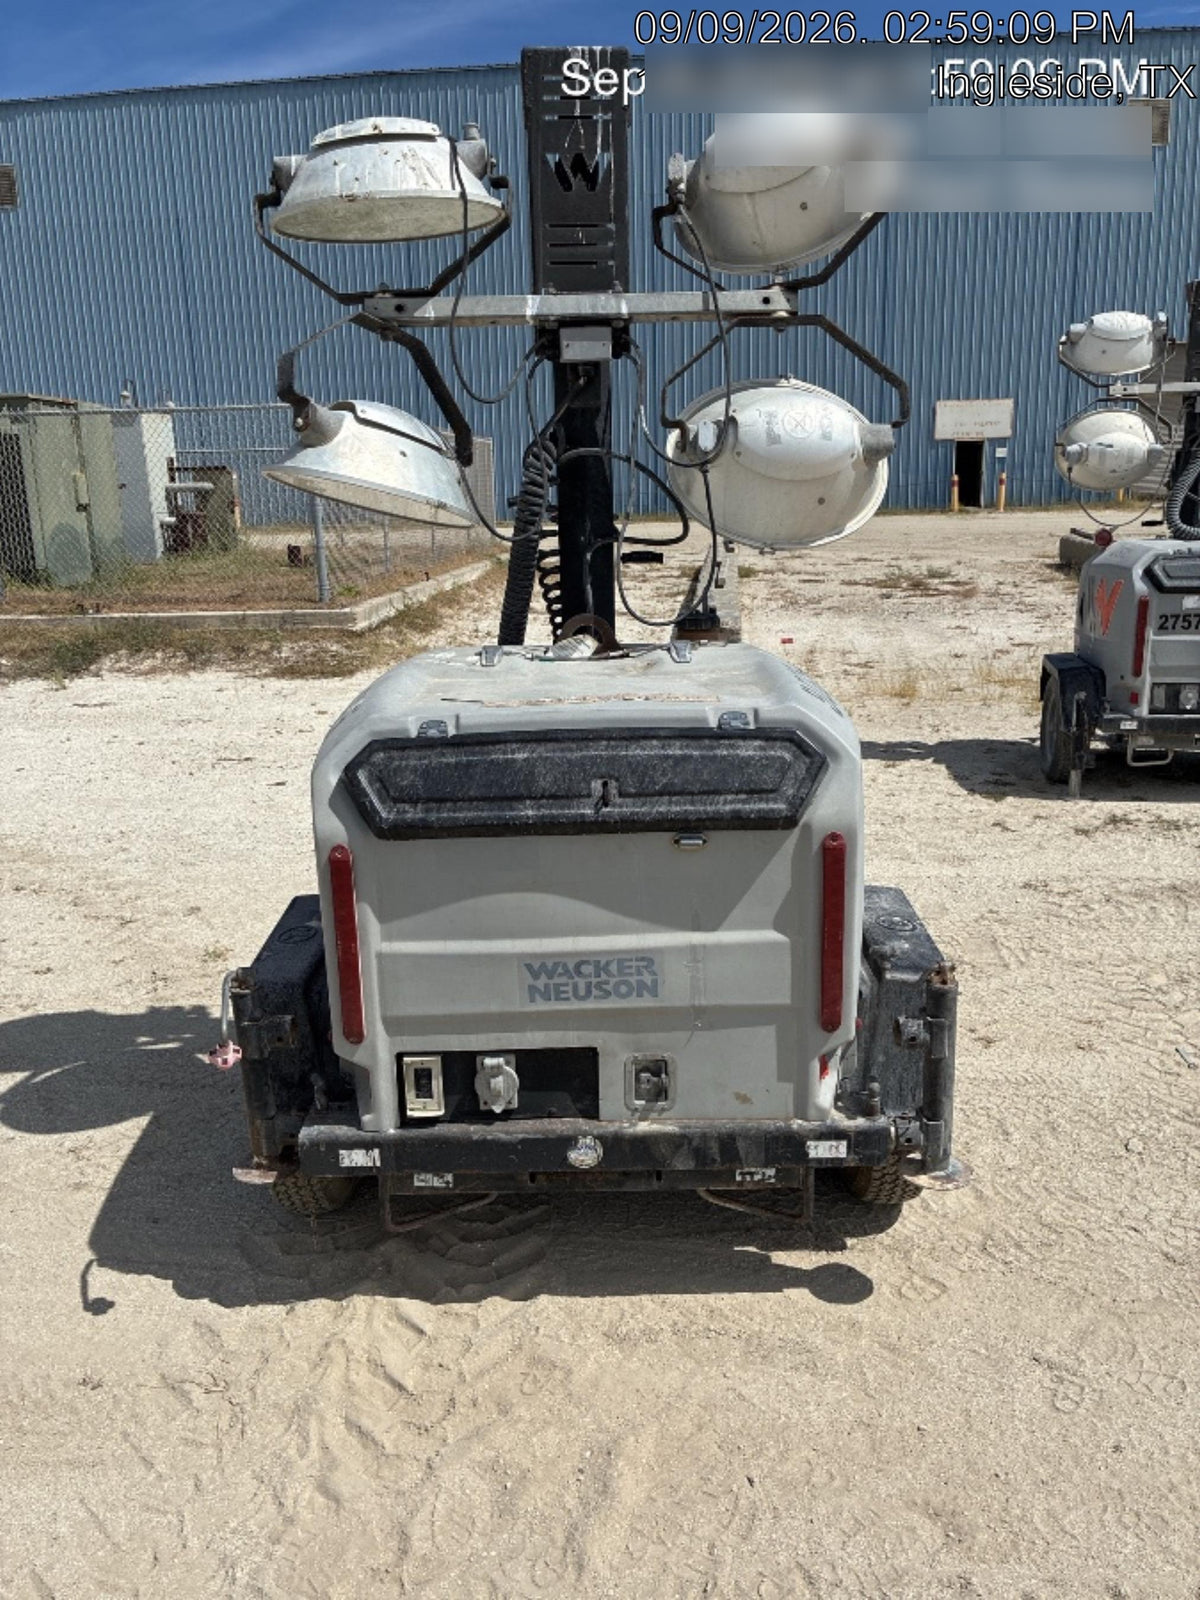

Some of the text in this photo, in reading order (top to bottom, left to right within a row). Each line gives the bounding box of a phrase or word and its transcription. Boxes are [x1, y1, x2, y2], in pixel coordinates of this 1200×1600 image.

[1158, 613, 1200, 631] 2757
[524, 956, 658, 981] WACKER
[527, 978, 658, 1003] NEUSON
